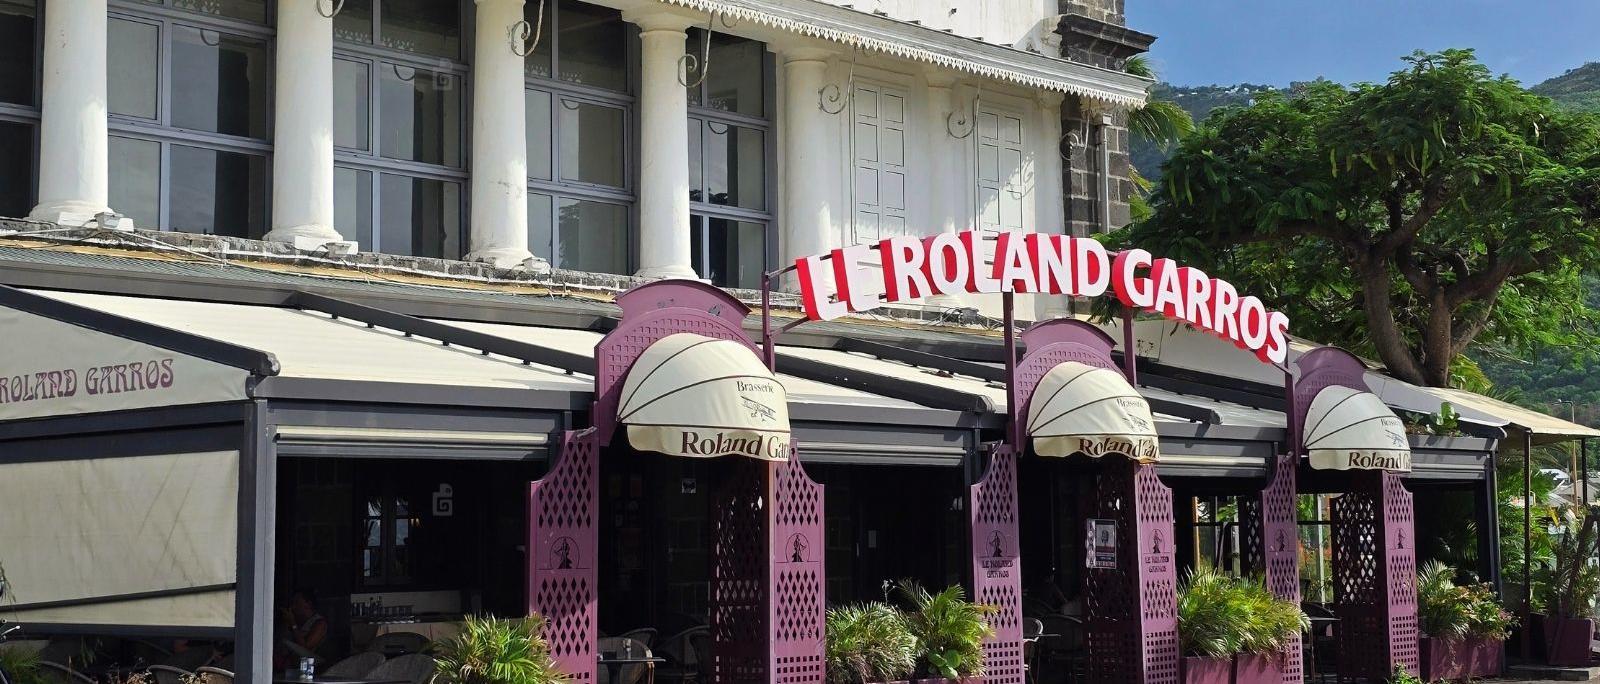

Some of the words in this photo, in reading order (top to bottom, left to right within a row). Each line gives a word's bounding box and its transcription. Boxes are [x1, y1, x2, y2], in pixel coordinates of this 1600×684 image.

[796, 244, 881, 321] LE
[880, 230, 1110, 302] ROLAND
[1112, 248, 1290, 365] GARROS
[0, 369, 77, 404] ROLAND
[86, 358, 174, 395] GARROS
[736, 380, 775, 393] Brasserie
[681, 431, 764, 456] Roland
[1079, 436, 1142, 457] Roland
[1348, 451, 1401, 469] Roland
